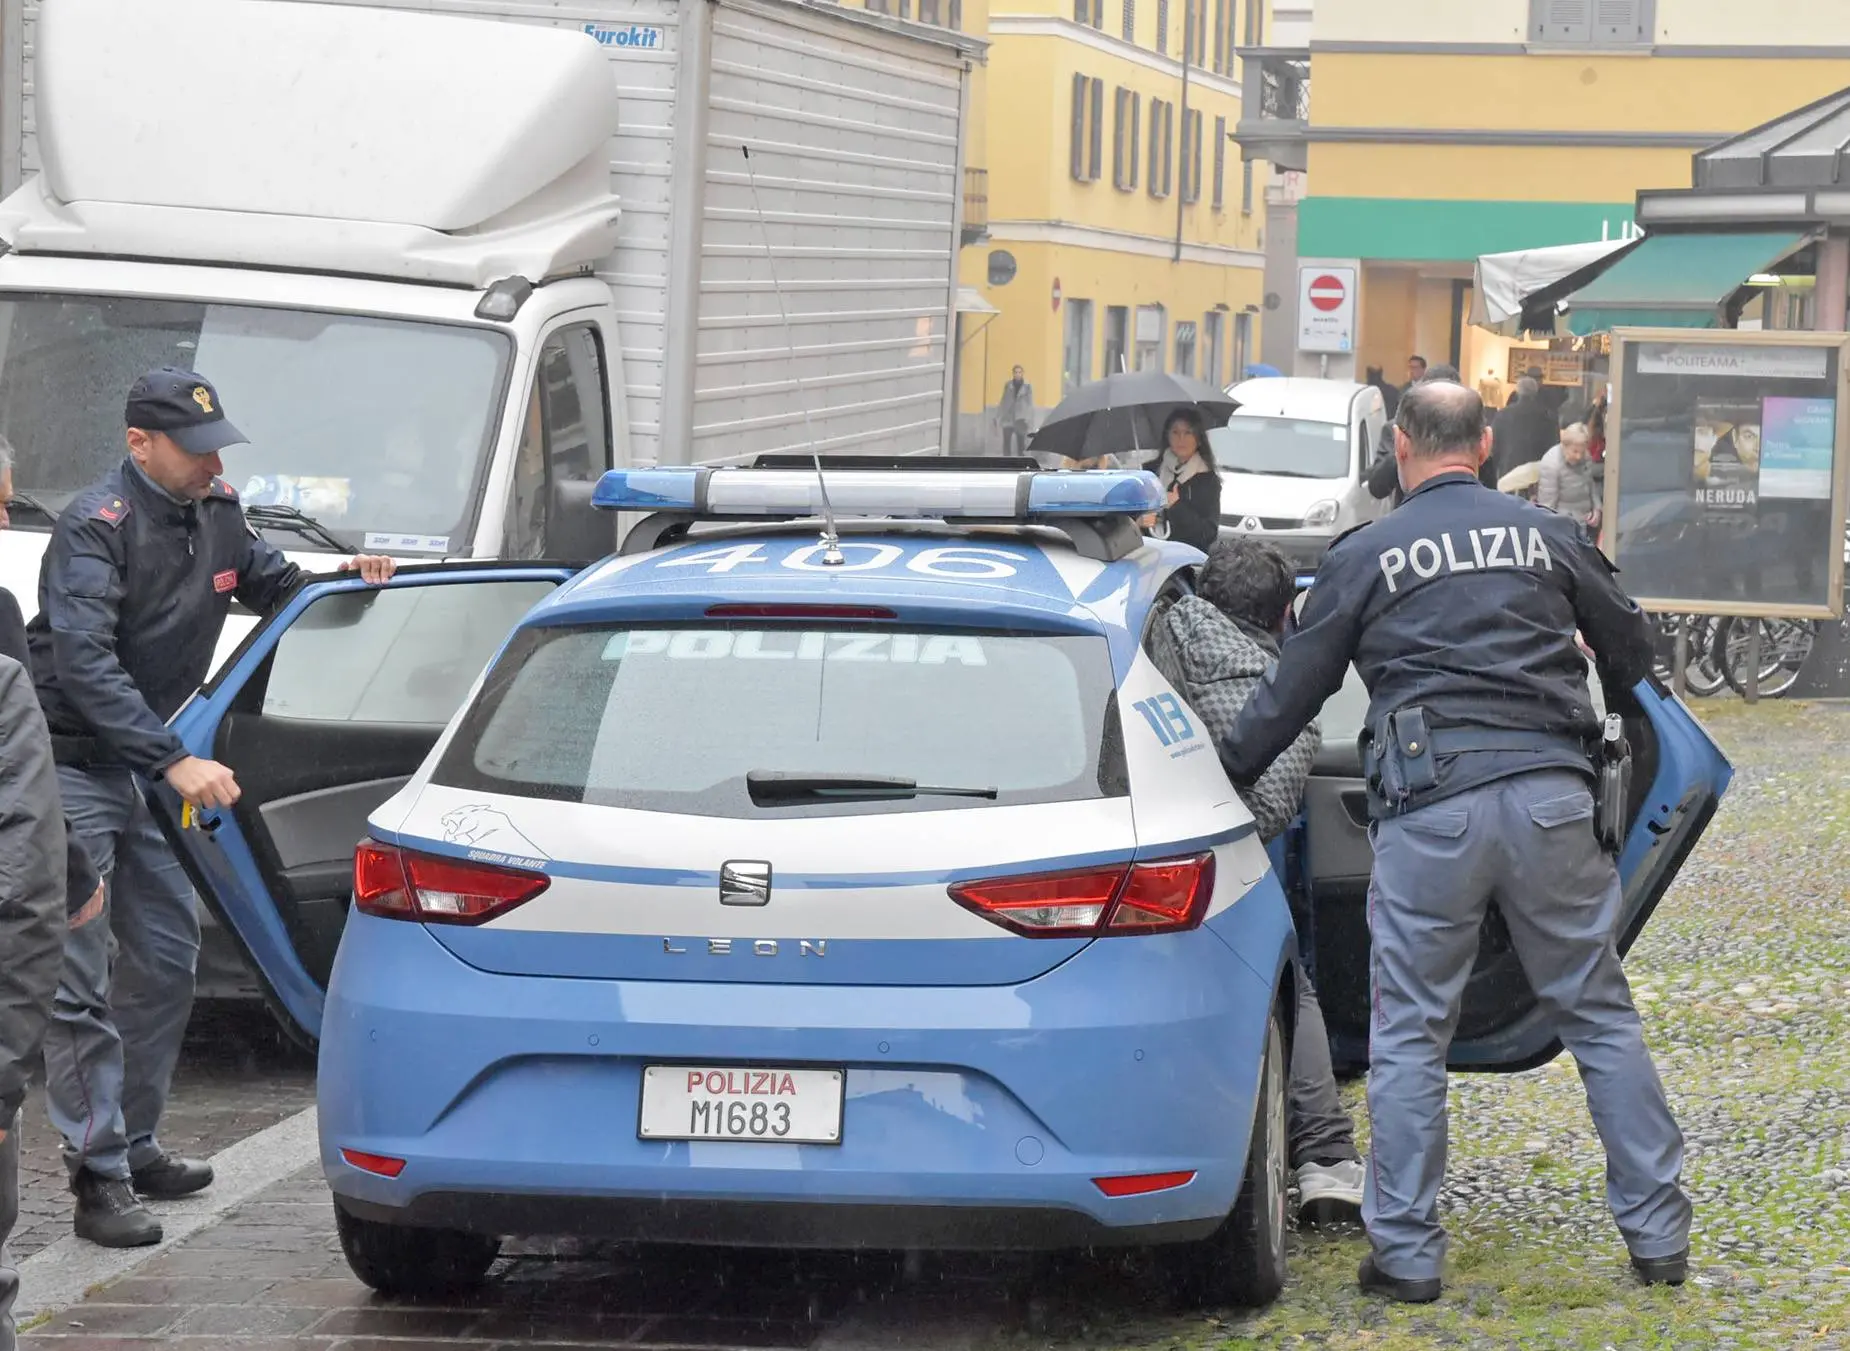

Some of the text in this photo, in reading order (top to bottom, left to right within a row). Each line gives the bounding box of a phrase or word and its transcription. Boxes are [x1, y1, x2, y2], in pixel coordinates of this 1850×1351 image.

[1666, 356, 1738, 368] POLITEAMA
[1695, 488, 1756, 504] NERUDA
[655, 542, 1029, 579] 406
[1379, 526, 1552, 593] POLIZIA
[601, 630, 988, 666] POLIZIA
[1132, 692, 1194, 747] 113
[467, 850, 548, 869] SQUADRA VOLANTE
[663, 937, 826, 957] LEON
[687, 1070, 796, 1096] POLIZIA
[690, 1100, 791, 1136] M1683
